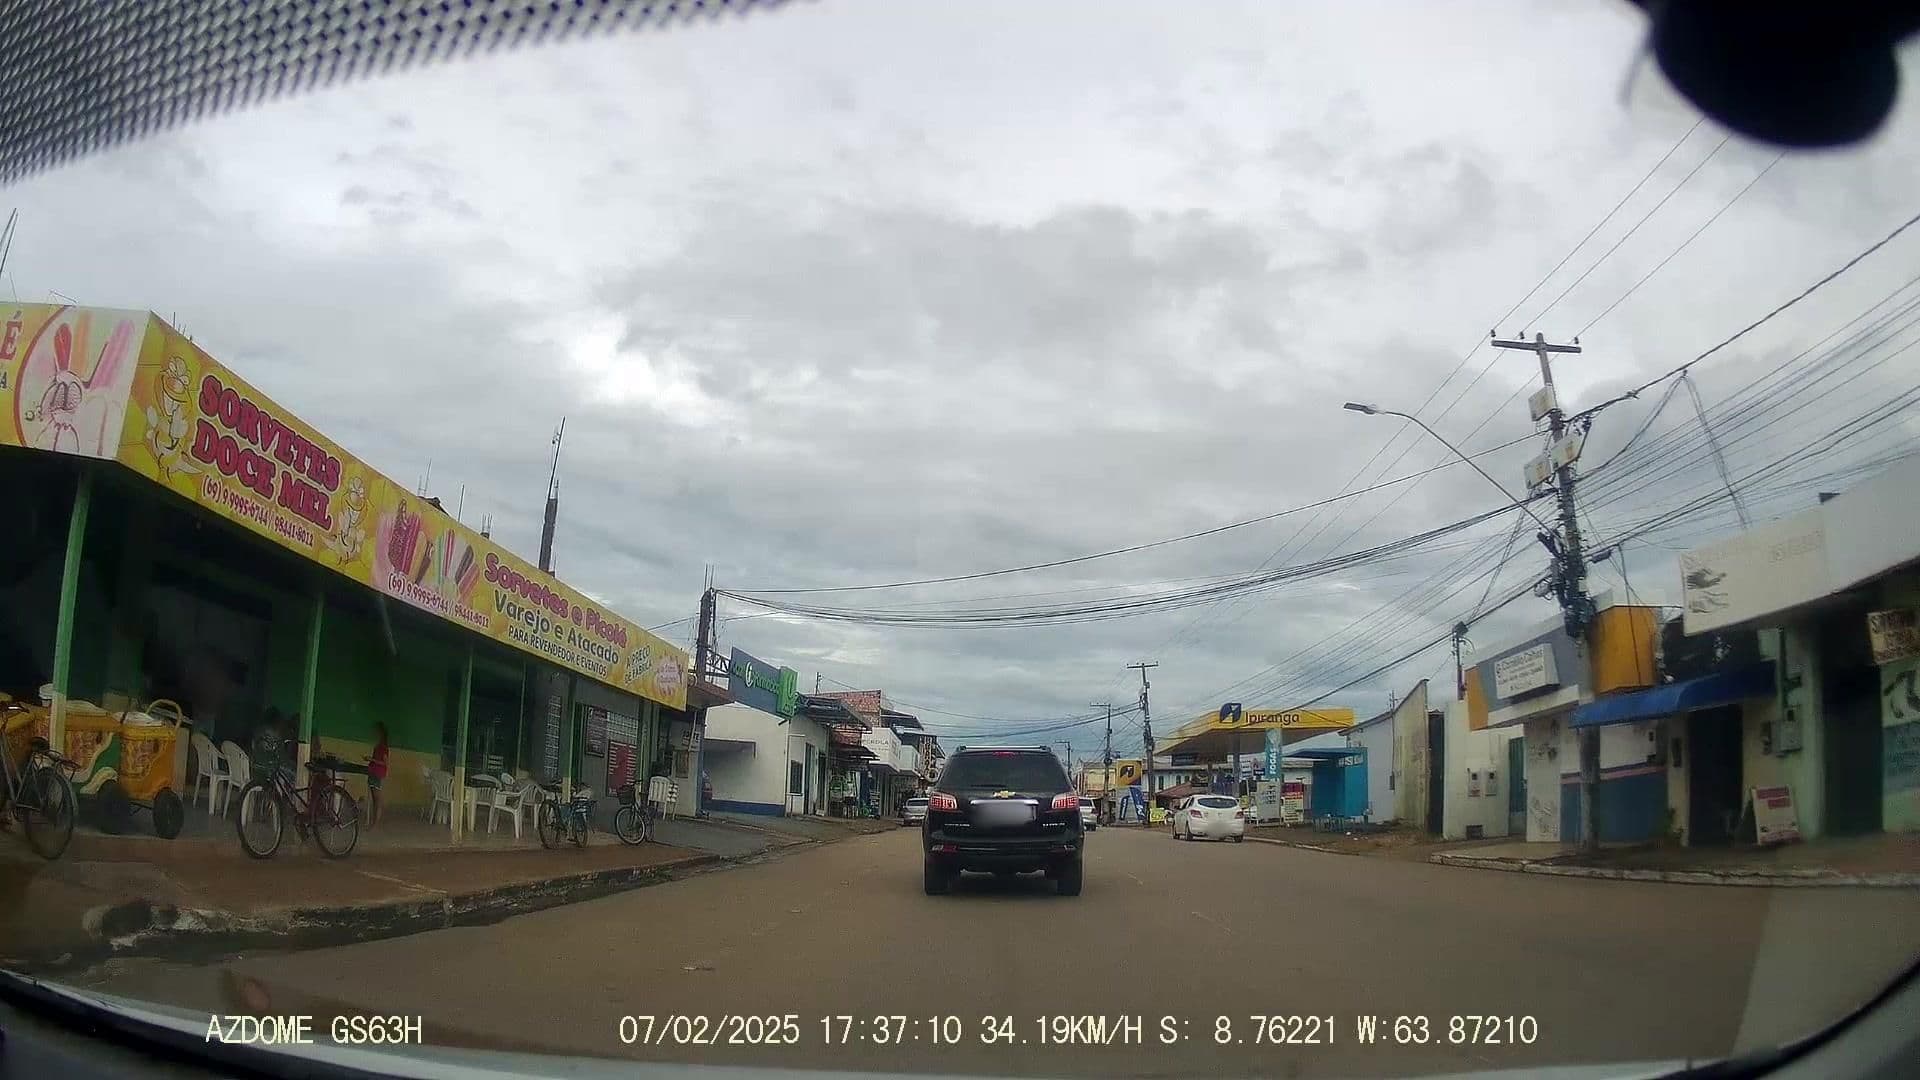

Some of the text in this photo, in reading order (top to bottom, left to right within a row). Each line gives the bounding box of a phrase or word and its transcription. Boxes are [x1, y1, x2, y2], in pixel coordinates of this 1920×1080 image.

[199, 375, 340, 491] SORVETES
[191, 418, 332, 530] DOCE MEL
[202, 474, 222, 503] (69)
[388, 573, 405, 595] (69)
[484, 552, 627, 648] Sorvetes e Picolé
[495, 589, 619, 664] Varejo e Atacado
[508, 625, 607, 677] PARA REVENDEDOR E EVENTOS
[1246, 711, 1299, 725] Ipiranga
